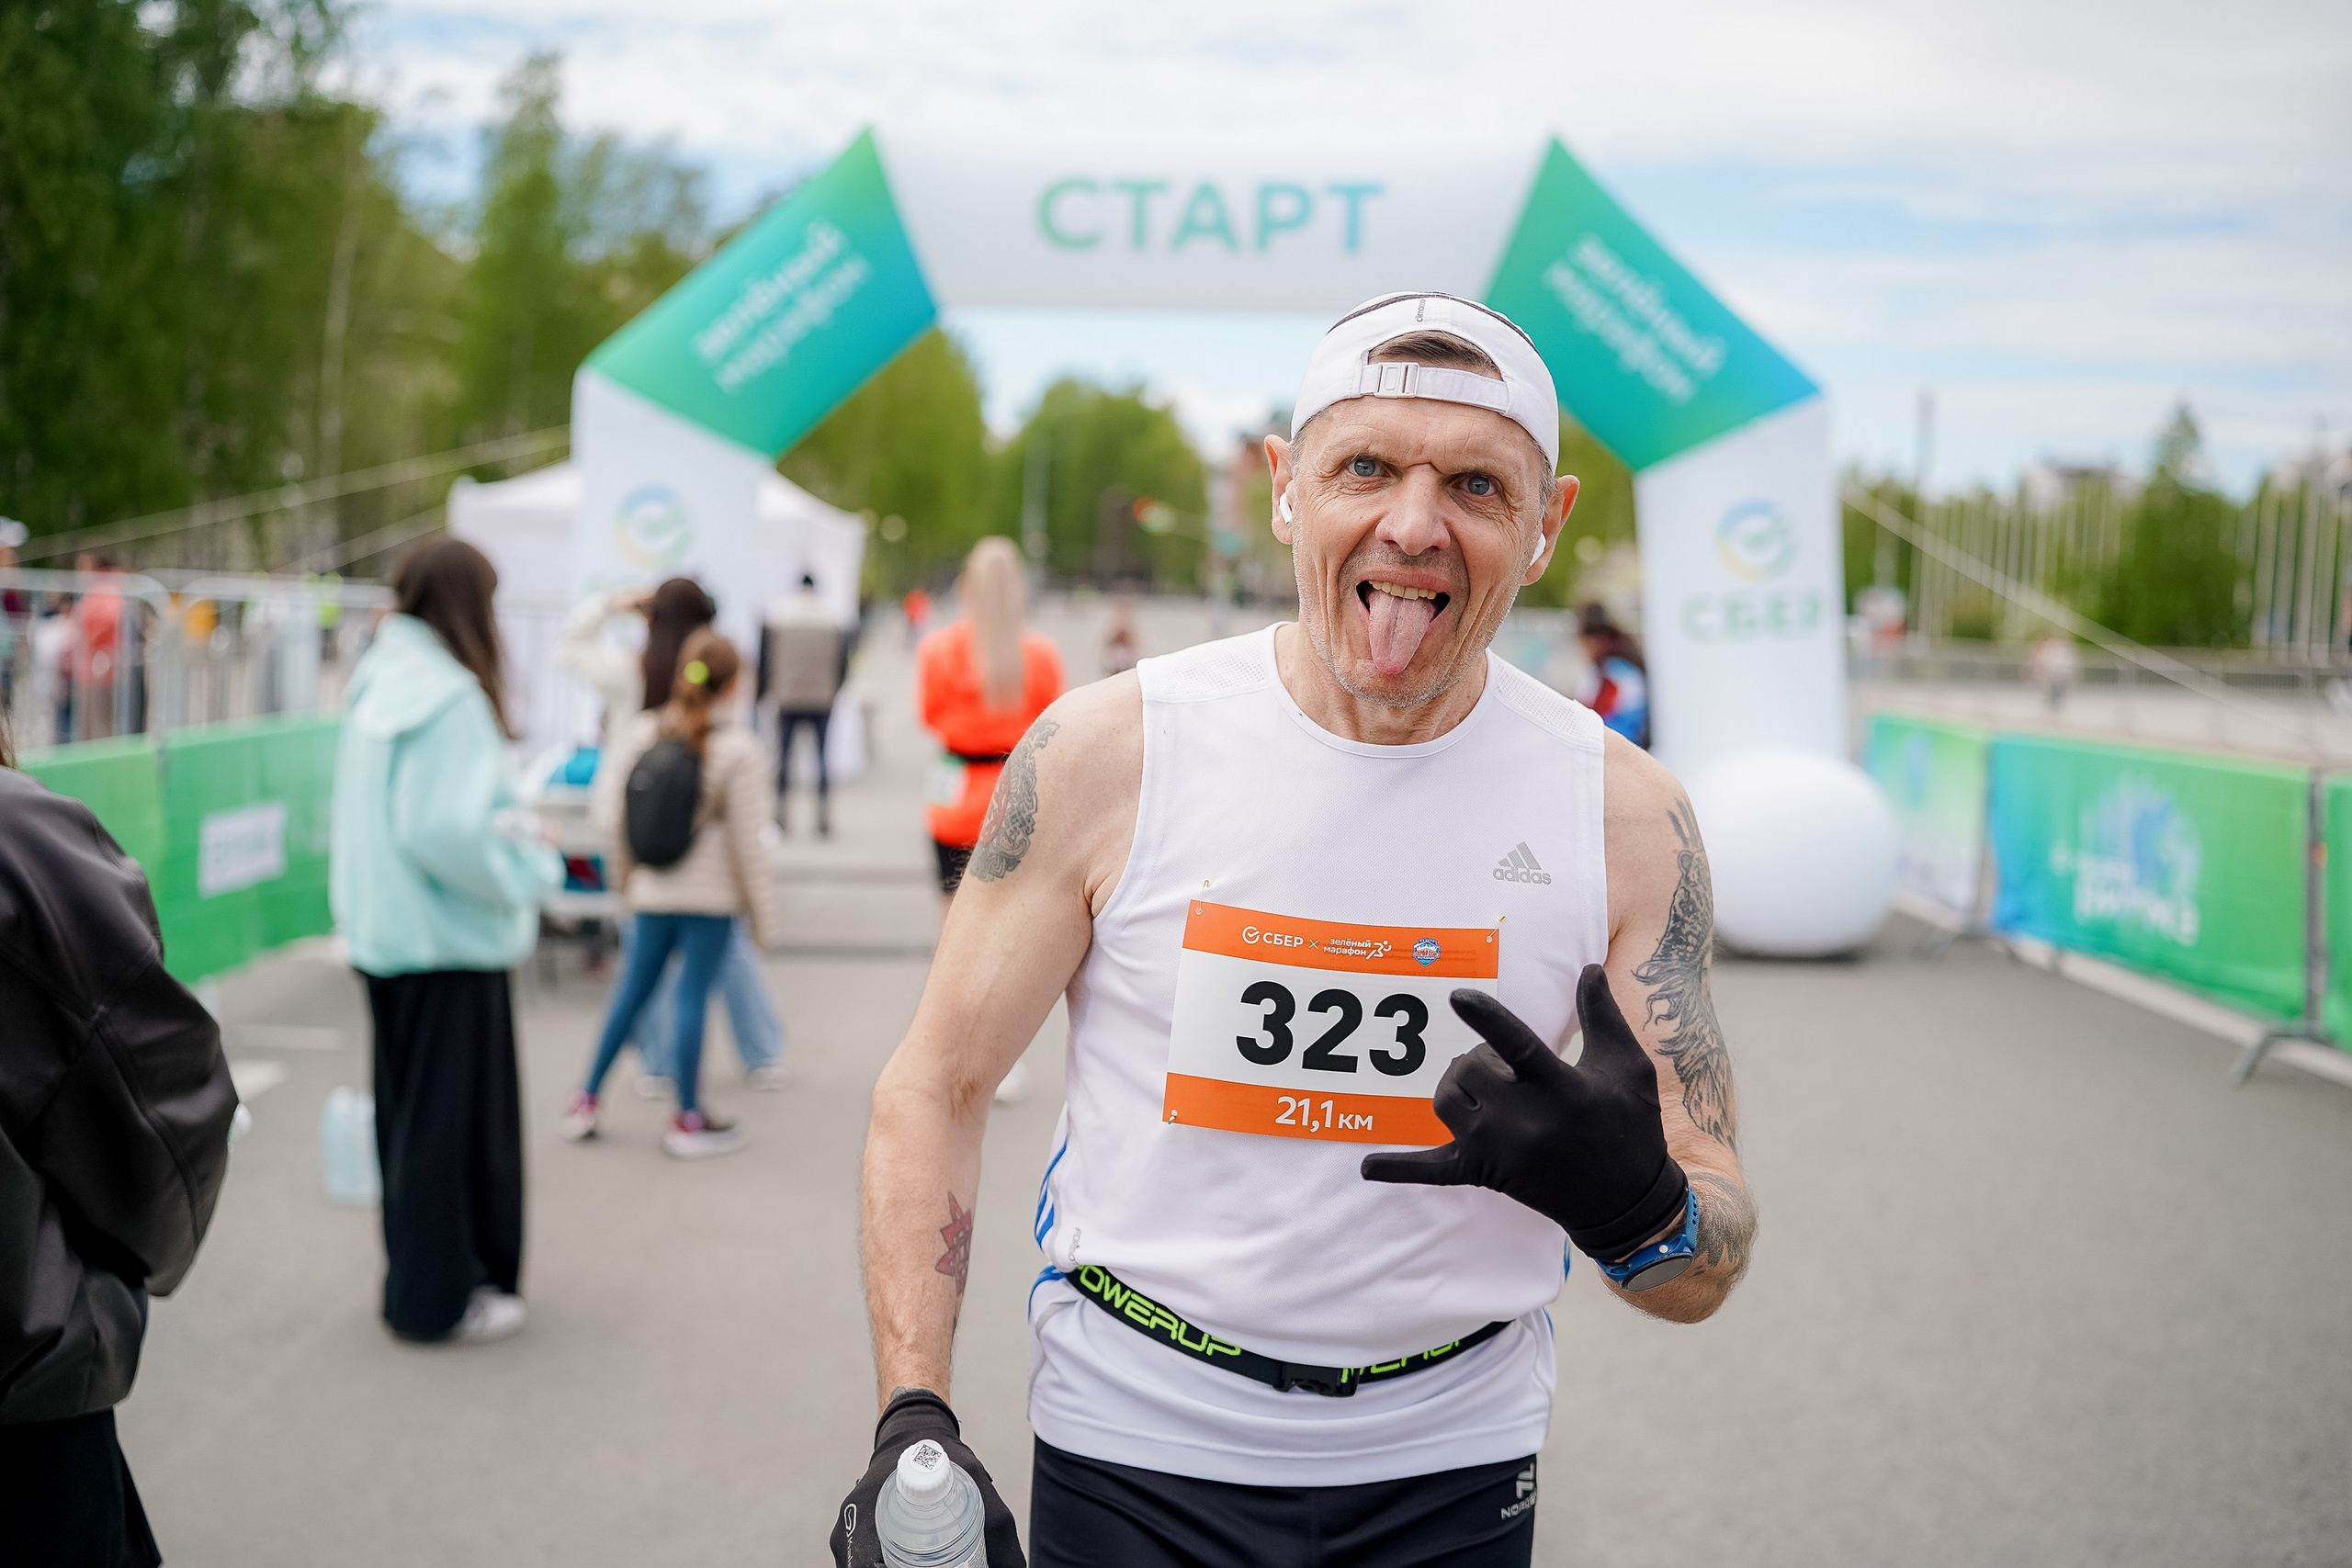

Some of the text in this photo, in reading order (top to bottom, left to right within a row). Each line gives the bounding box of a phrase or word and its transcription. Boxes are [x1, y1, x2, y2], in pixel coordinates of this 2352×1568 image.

[1035, 177, 1384, 254] СТАРТ
[1492, 866, 1552, 885] adidas
[1262, 931, 1304, 948] СБЕР
[1323, 946, 1367, 957] марафон
[1329, 937, 1372, 948] зелёный
[1236, 980, 1430, 1077] 323
[1274, 1096, 1334, 1133] 21,1
[1078, 1264, 1242, 1357] OWERUP
